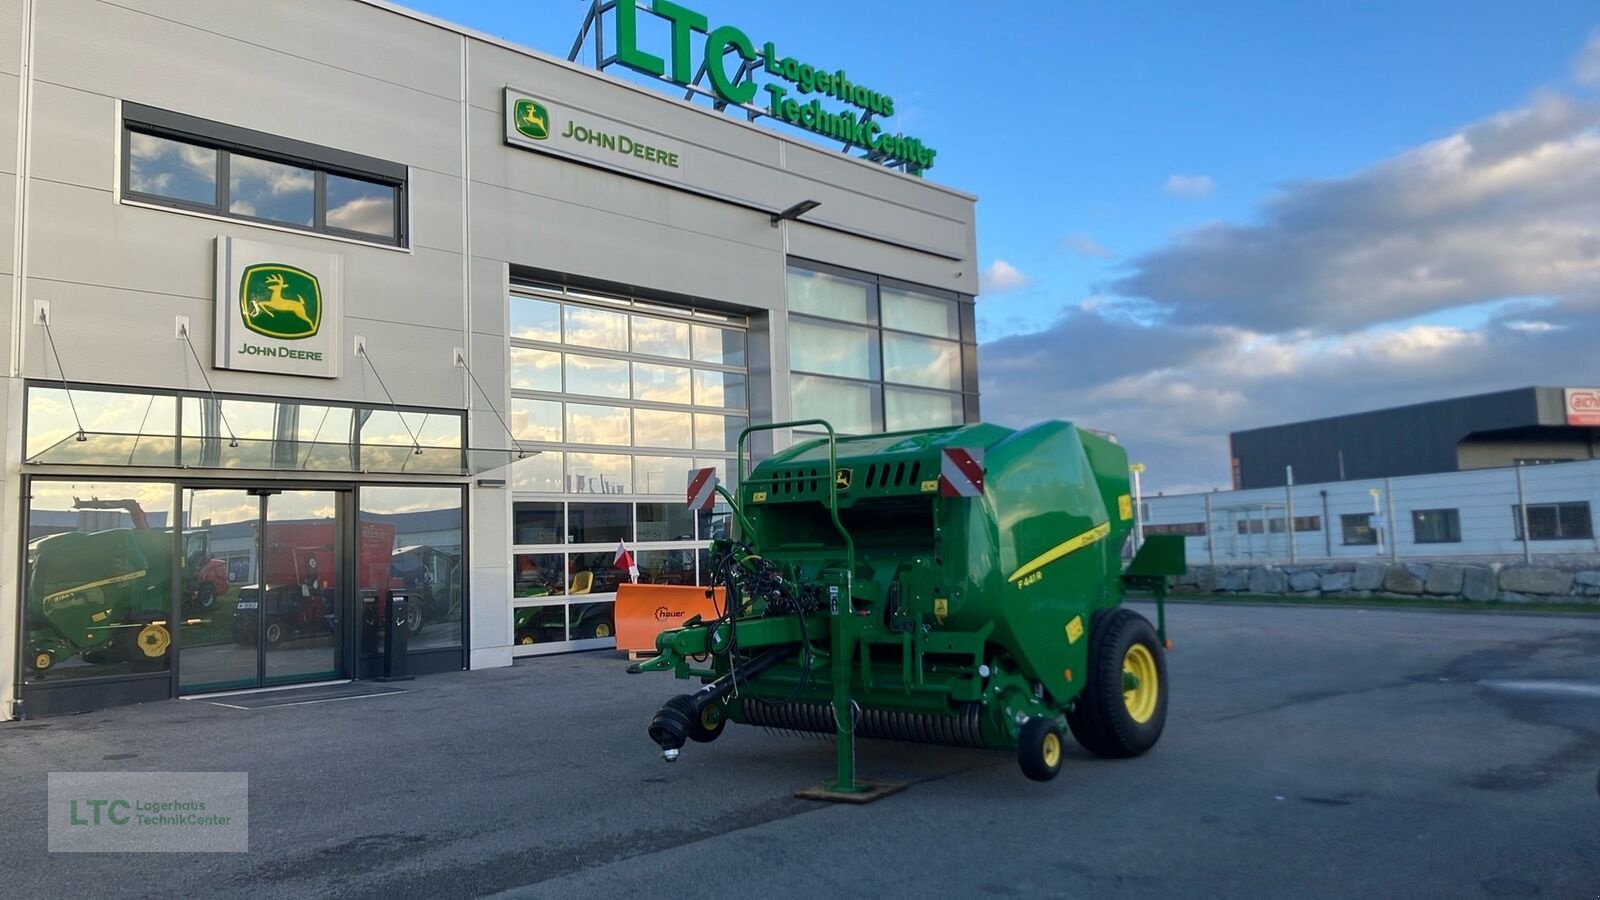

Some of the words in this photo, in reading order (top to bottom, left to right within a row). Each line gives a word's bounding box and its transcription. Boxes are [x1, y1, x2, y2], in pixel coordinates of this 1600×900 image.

[616, 0, 758, 105] LTC
[763, 41, 894, 117] Lagerhaus
[562, 120, 615, 151] JOHN
[618, 135, 679, 168] DEERE
[764, 83, 937, 170] TechnikCenter
[238, 343, 277, 357] JOHN
[278, 346, 323, 361] DEERE
[659, 609, 686, 618] hauer
